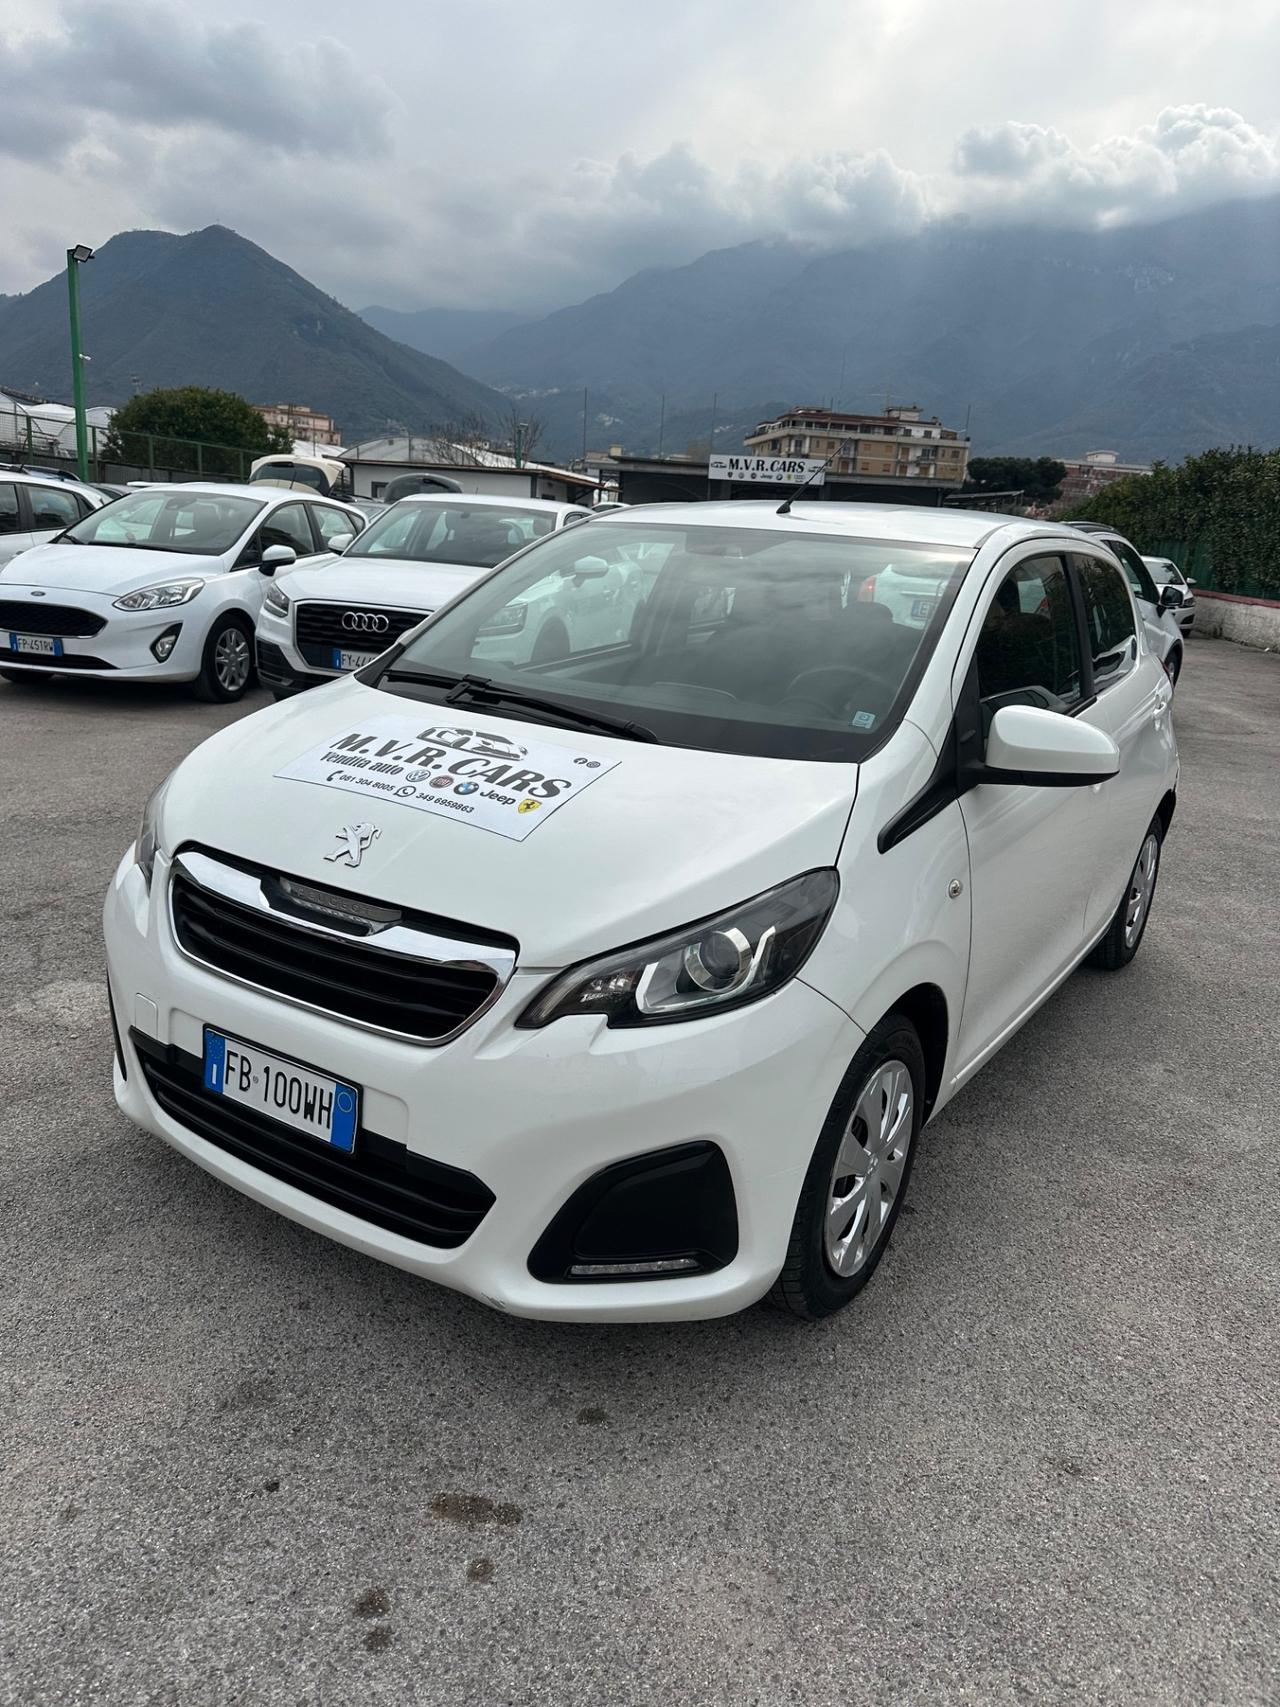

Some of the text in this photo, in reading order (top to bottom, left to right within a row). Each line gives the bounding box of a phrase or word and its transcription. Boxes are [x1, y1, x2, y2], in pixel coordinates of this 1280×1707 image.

[728, 458, 805, 473] M.V.R.CARS
[320, 751, 405, 775] Vendita auto
[339, 774, 396, 792] 081 304 8005
[415, 792, 435, 802] 349
[479, 789, 517, 806] Jeep
[225, 1049, 333, 1129] FB 100WH
